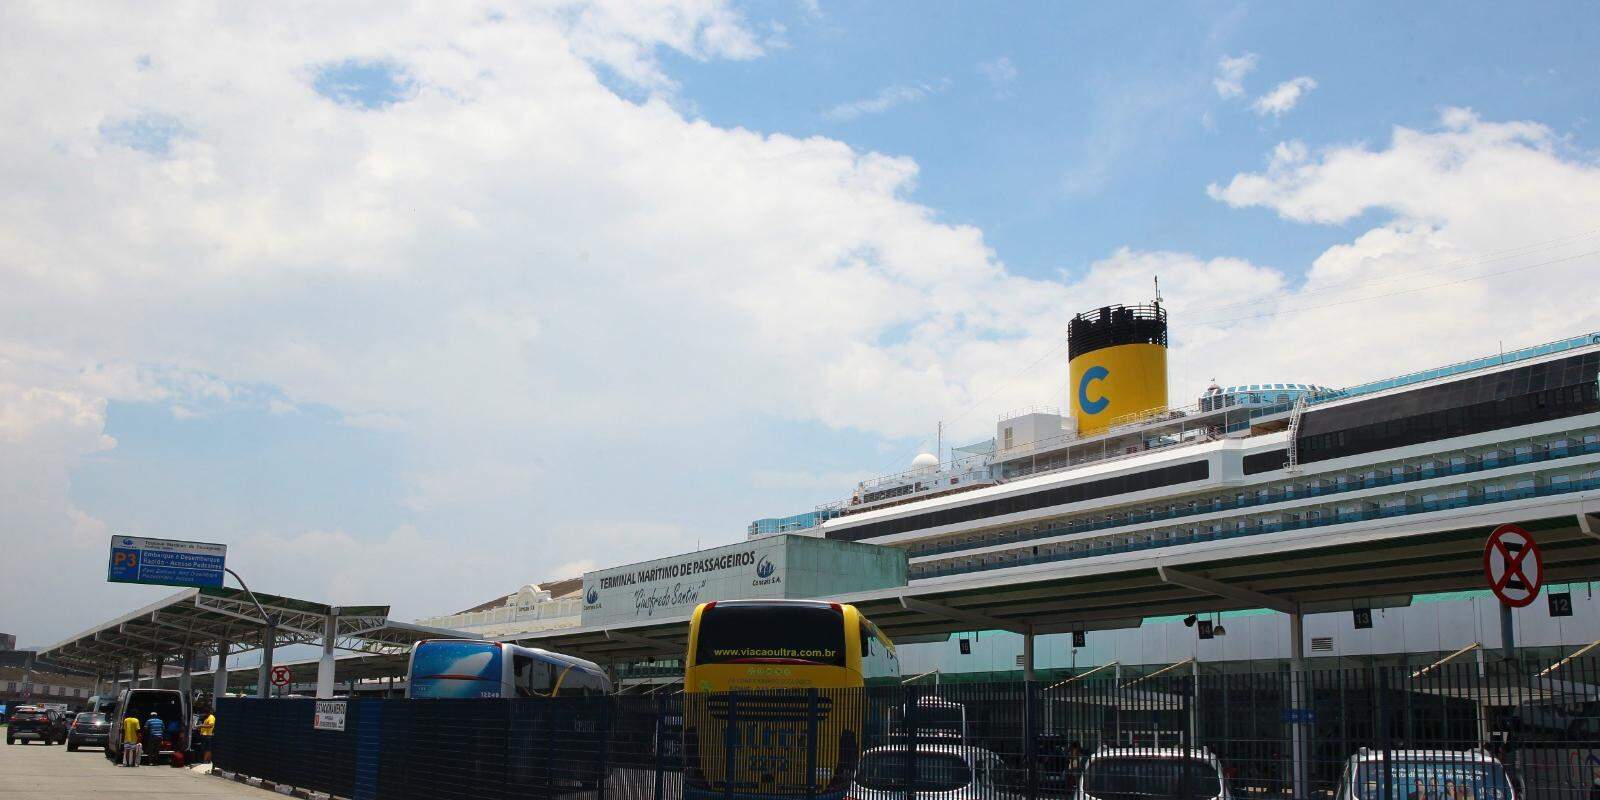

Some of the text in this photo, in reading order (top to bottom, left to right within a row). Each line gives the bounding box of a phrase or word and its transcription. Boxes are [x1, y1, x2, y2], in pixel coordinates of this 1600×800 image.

[1078, 365, 1109, 415] C
[115, 552, 136, 568] P3
[600, 550, 756, 590] TERMINAL MARÍTIMO DE PASSAGEIROS
[1552, 598, 1569, 611] 12
[1355, 612, 1369, 624] 13
[713, 647, 837, 657] www.viacaoultra.com.br
